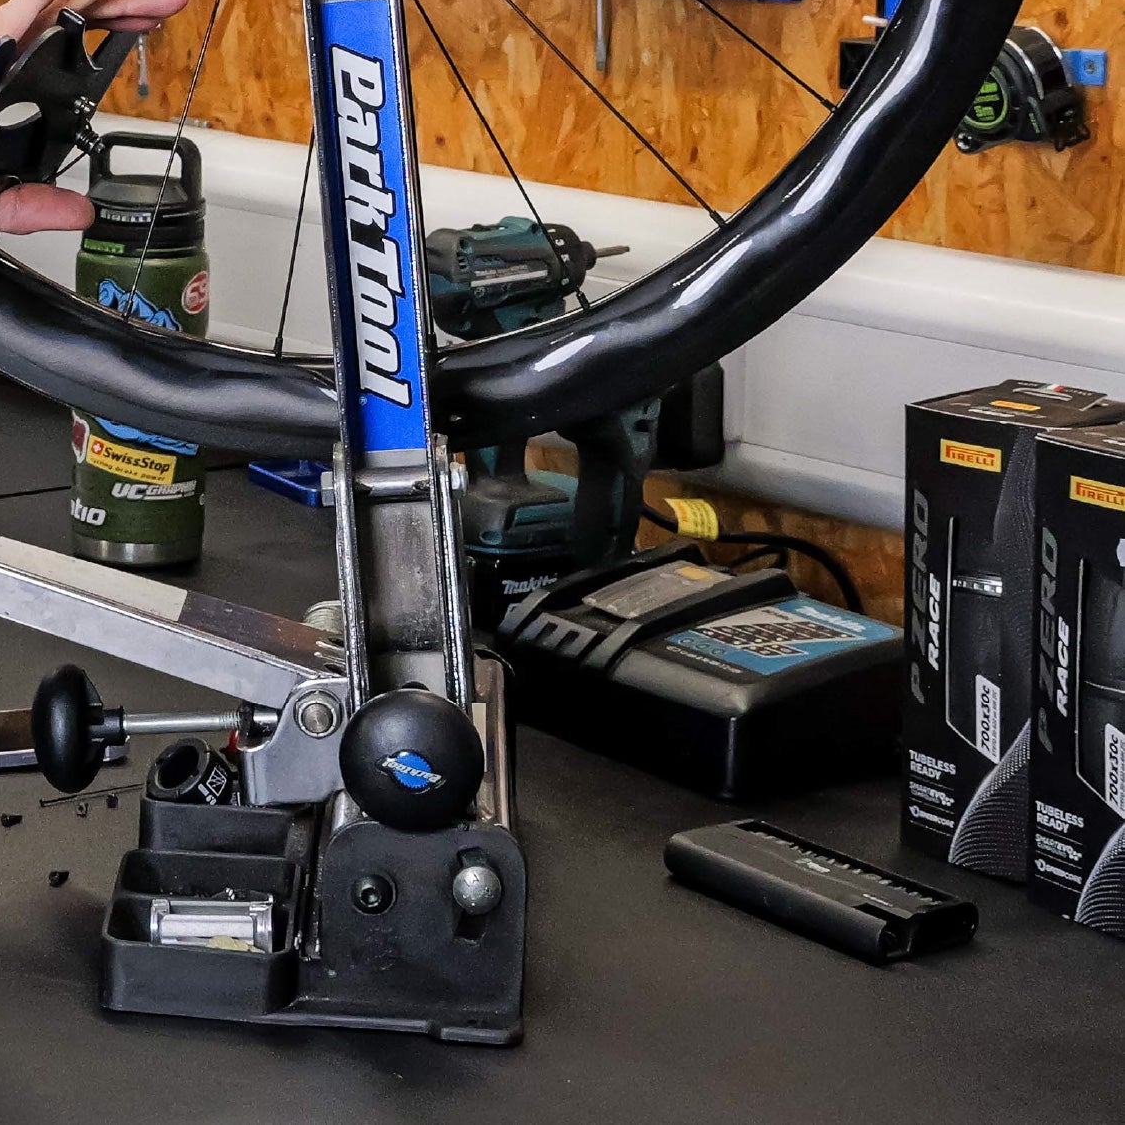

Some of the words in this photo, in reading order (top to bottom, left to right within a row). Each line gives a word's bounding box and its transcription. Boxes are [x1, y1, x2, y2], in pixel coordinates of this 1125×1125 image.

[330, 44, 412, 408] ParkTool
[103, 446, 171, 474] SwissStop
[946, 445, 997, 468] PIRELLI
[911, 488, 929, 656] ZERO
[928, 572, 941, 671] RACE
[1040, 526, 1058, 703] ZERO
[1056, 615, 1070, 718] RACE
[981, 685, 991, 753] 700x30c
[908, 749, 957, 775] TUBELESS
[910, 760, 942, 781] READY
[1109, 733, 1119, 807] 700x30c
[1035, 800, 1084, 829] TUBELESS
[1036, 812, 1069, 834] READY
